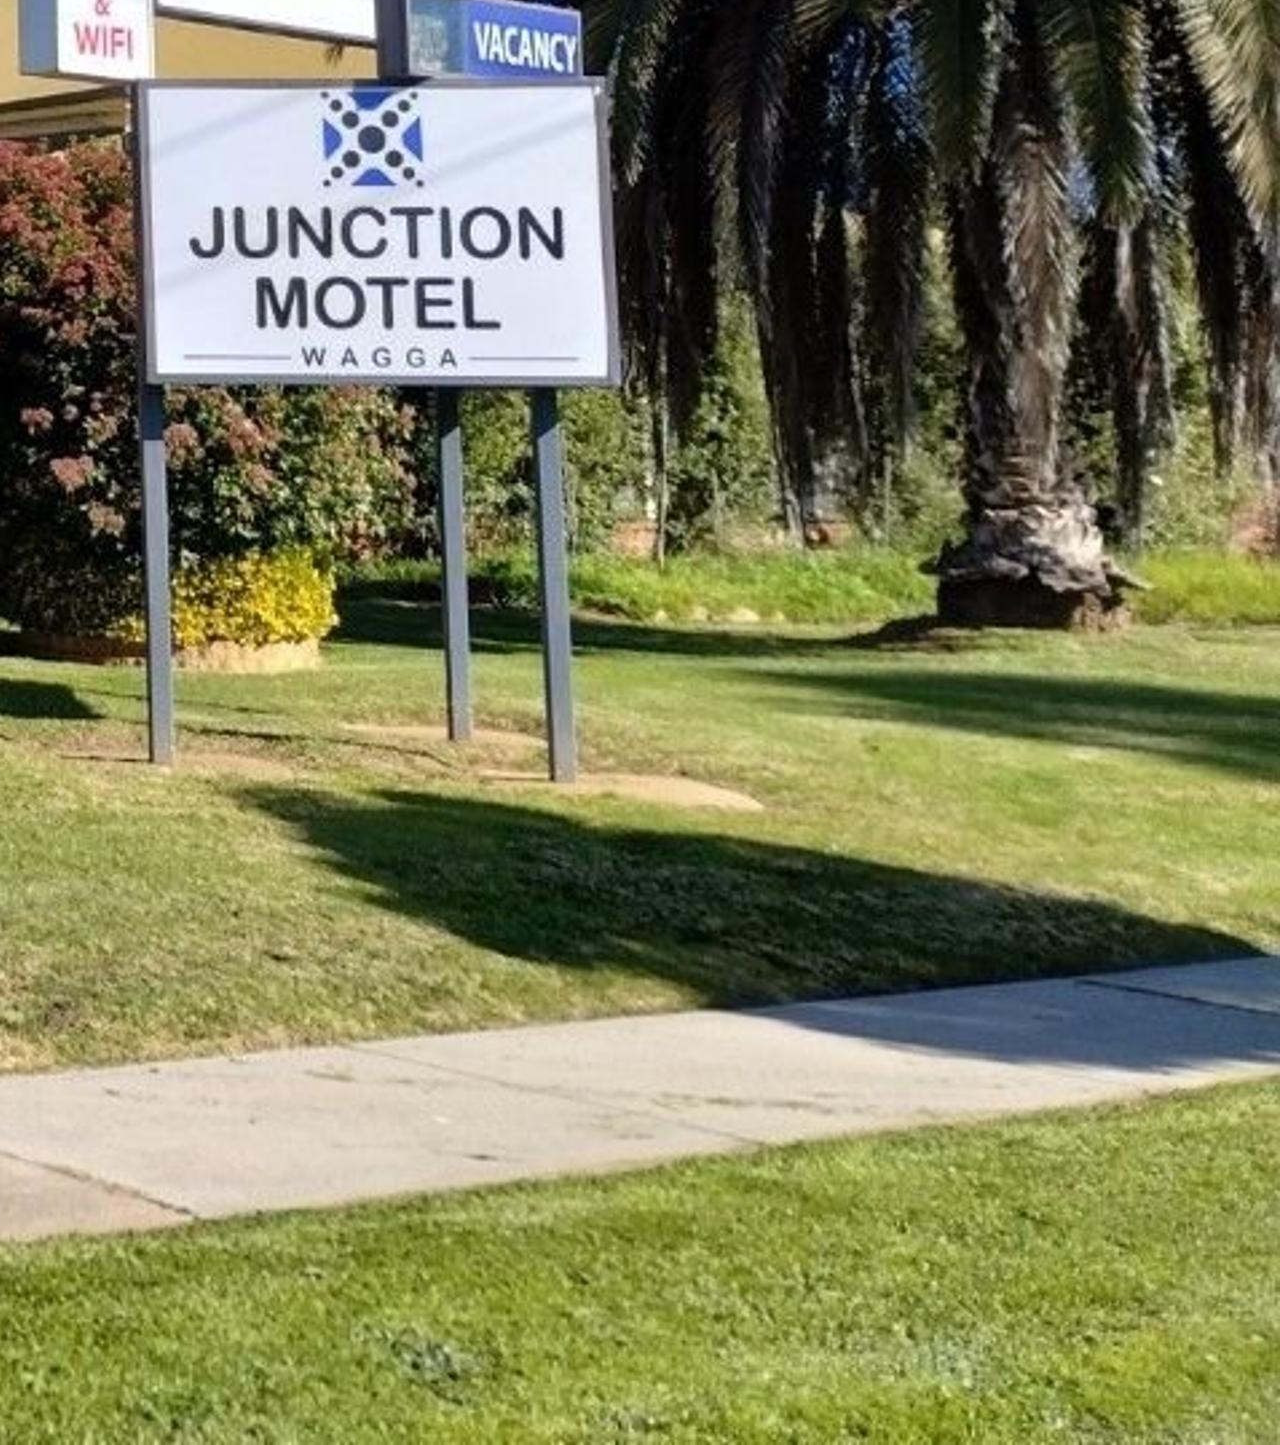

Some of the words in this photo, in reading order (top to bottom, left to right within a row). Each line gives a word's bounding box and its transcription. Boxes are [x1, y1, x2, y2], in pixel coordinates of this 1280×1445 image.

[73, 20, 134, 60] WIFI
[472, 20, 576, 74] VACANCY
[188, 206, 564, 260] JUNCTION
[255, 276, 501, 329] MOTEL
[301, 347, 458, 368] WAGGA
